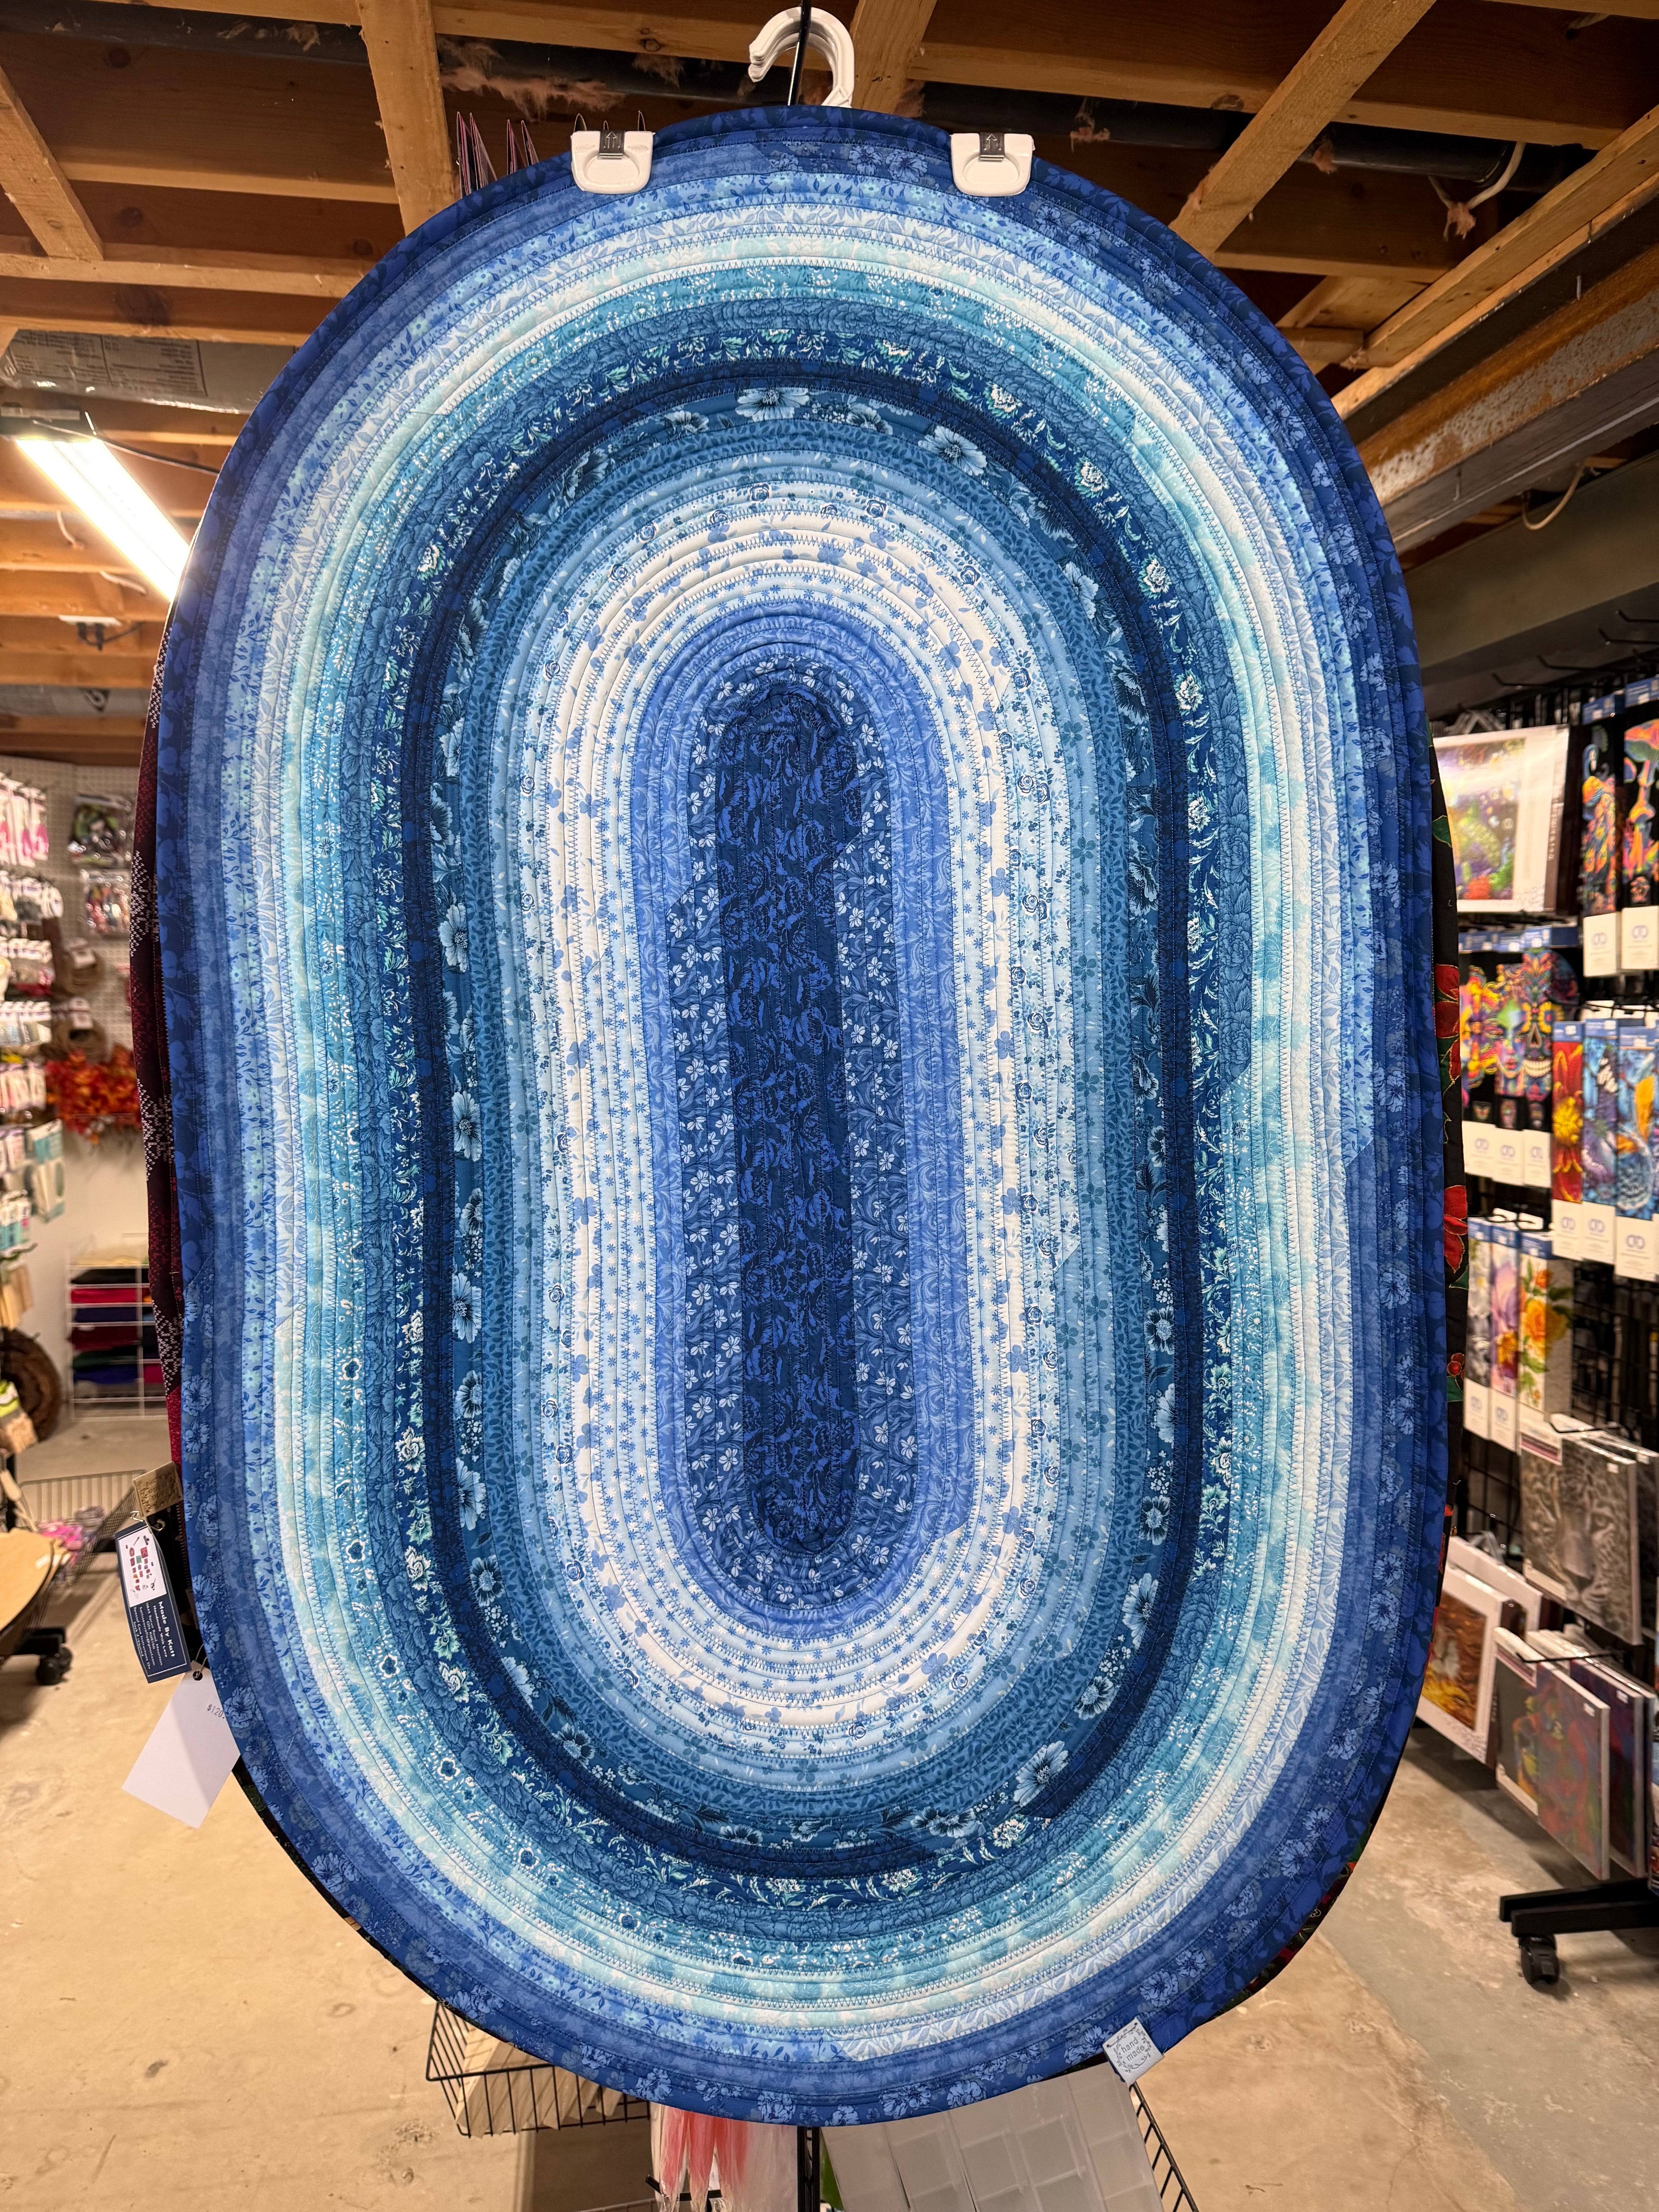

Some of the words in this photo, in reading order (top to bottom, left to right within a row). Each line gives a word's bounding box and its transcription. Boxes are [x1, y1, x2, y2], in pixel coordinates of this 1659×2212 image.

[158, 1601, 167, 1624] Made
[165, 1627, 169, 1637] By
[1121, 2037, 1139, 2053] hand
[1127, 2045, 1145, 2061] made
